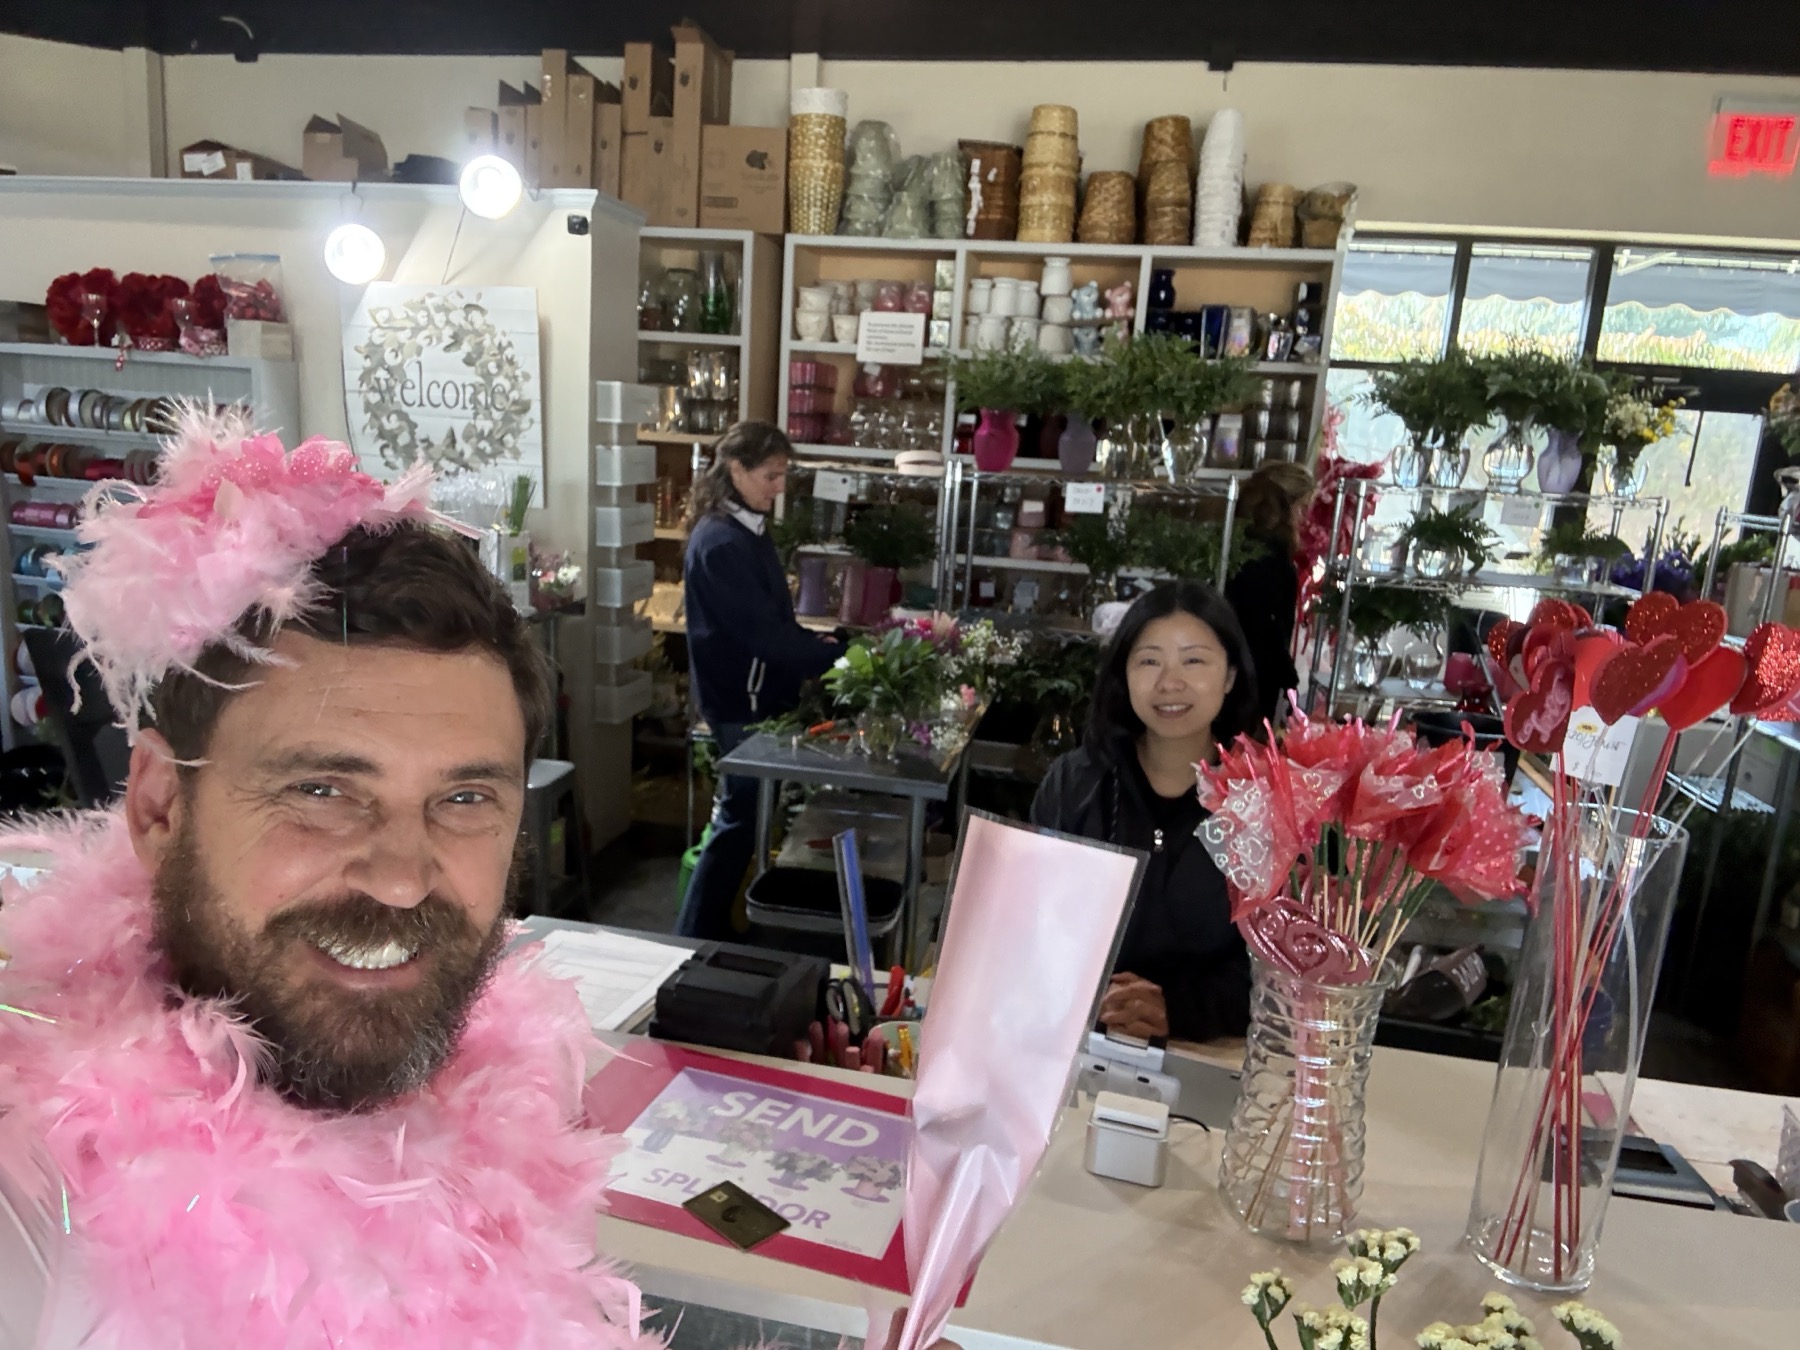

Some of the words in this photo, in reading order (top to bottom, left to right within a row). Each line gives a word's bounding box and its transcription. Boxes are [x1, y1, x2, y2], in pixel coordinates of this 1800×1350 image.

[1726, 116, 1795, 162] EXIT
[374, 360, 509, 412] welcome
[709, 1091, 880, 1148] SEND
[641, 1168, 831, 1229] SPLOR
